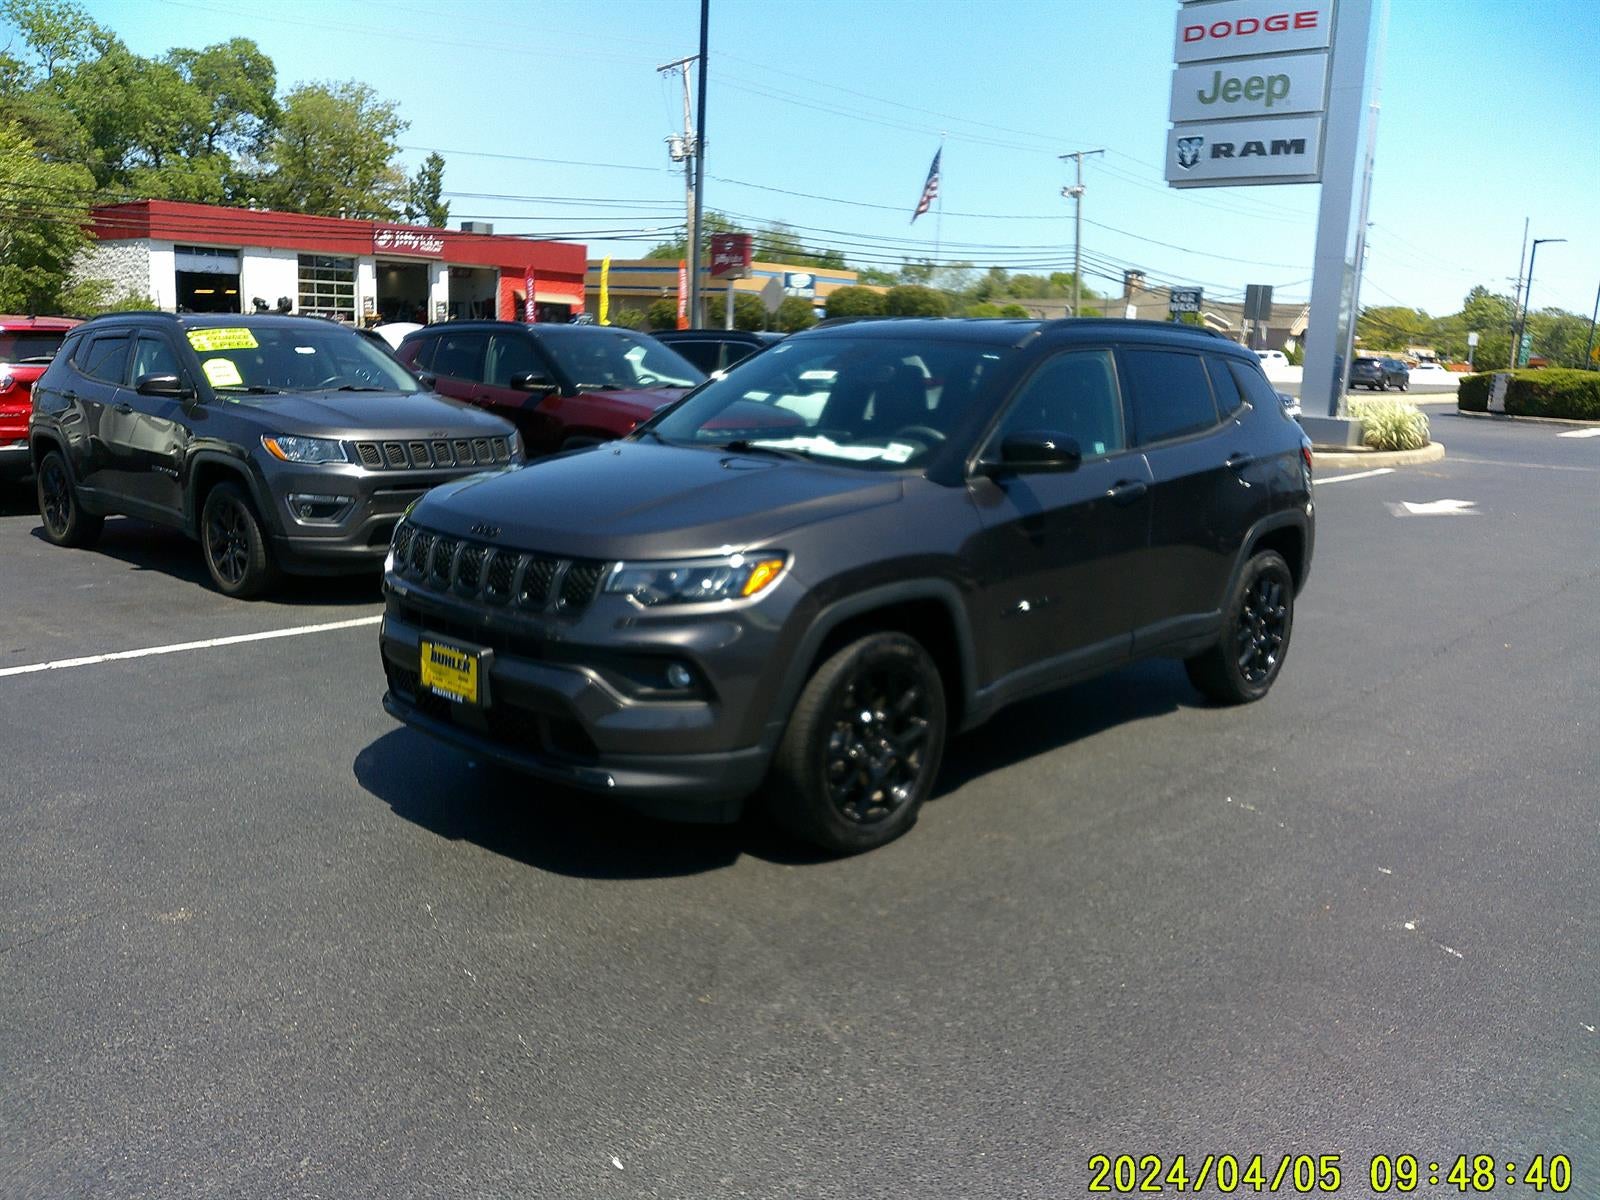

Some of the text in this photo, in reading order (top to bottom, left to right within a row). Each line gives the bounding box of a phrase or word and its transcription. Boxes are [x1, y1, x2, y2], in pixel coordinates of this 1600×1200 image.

[1184, 11, 1318, 42] DODGE
[1197, 70, 1291, 107] Jeep
[1210, 138, 1307, 159] RAM
[1170, 302, 1200, 312] WASH
[431, 650, 471, 674] BUHLER
